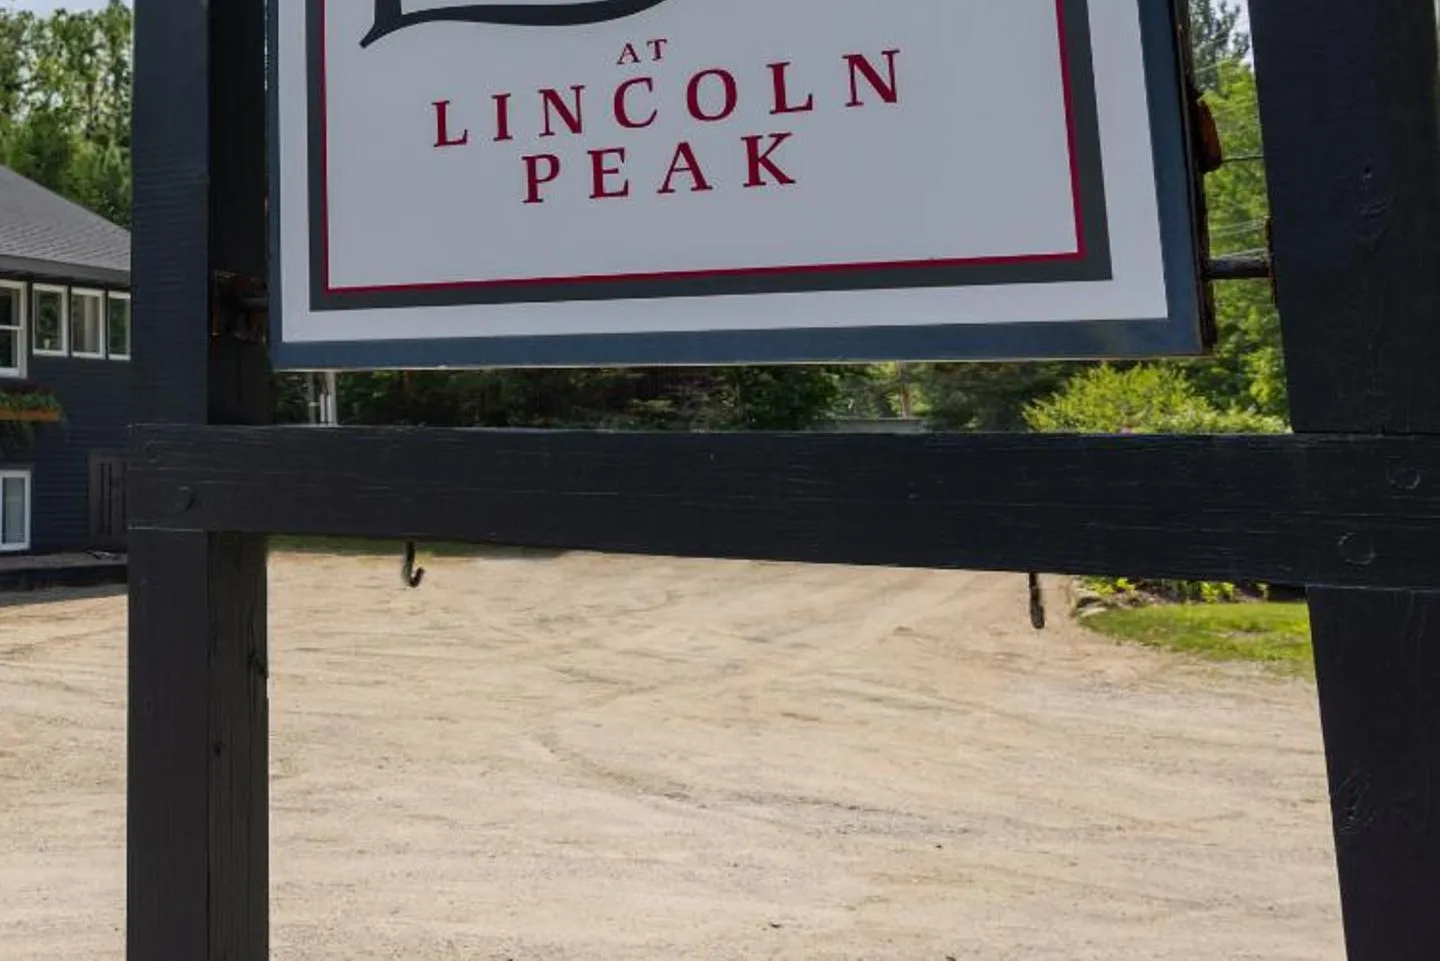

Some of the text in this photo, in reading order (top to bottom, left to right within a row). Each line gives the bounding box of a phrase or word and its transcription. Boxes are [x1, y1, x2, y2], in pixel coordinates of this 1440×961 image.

[616, 38, 668, 66] AT
[431, 48, 901, 148] LINCOLN
[521, 131, 798, 204] PEAK
